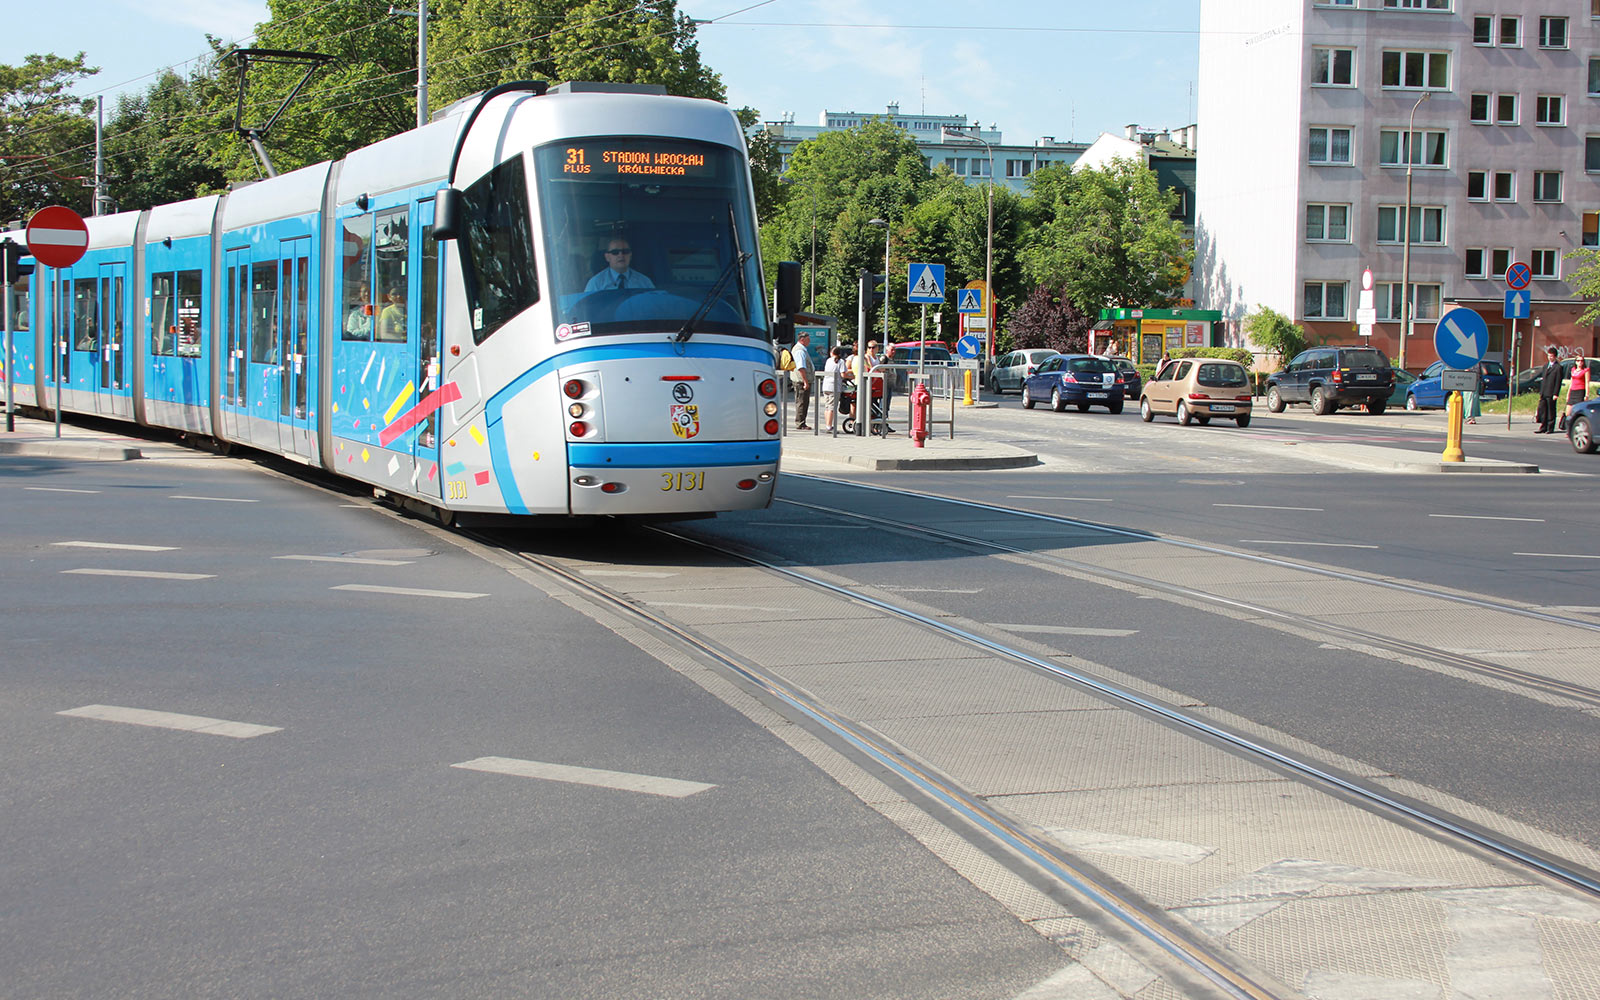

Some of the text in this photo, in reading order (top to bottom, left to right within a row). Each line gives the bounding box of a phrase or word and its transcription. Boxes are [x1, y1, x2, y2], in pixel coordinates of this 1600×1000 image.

[566, 148, 585, 164] 31
[602, 151, 704, 166] STADION WROCŁAW
[563, 164, 591, 174] PLUS
[617, 164, 685, 175] KRÓLEWIECKA
[661, 472, 704, 491] 3131
[448, 480, 468, 499] 3131
